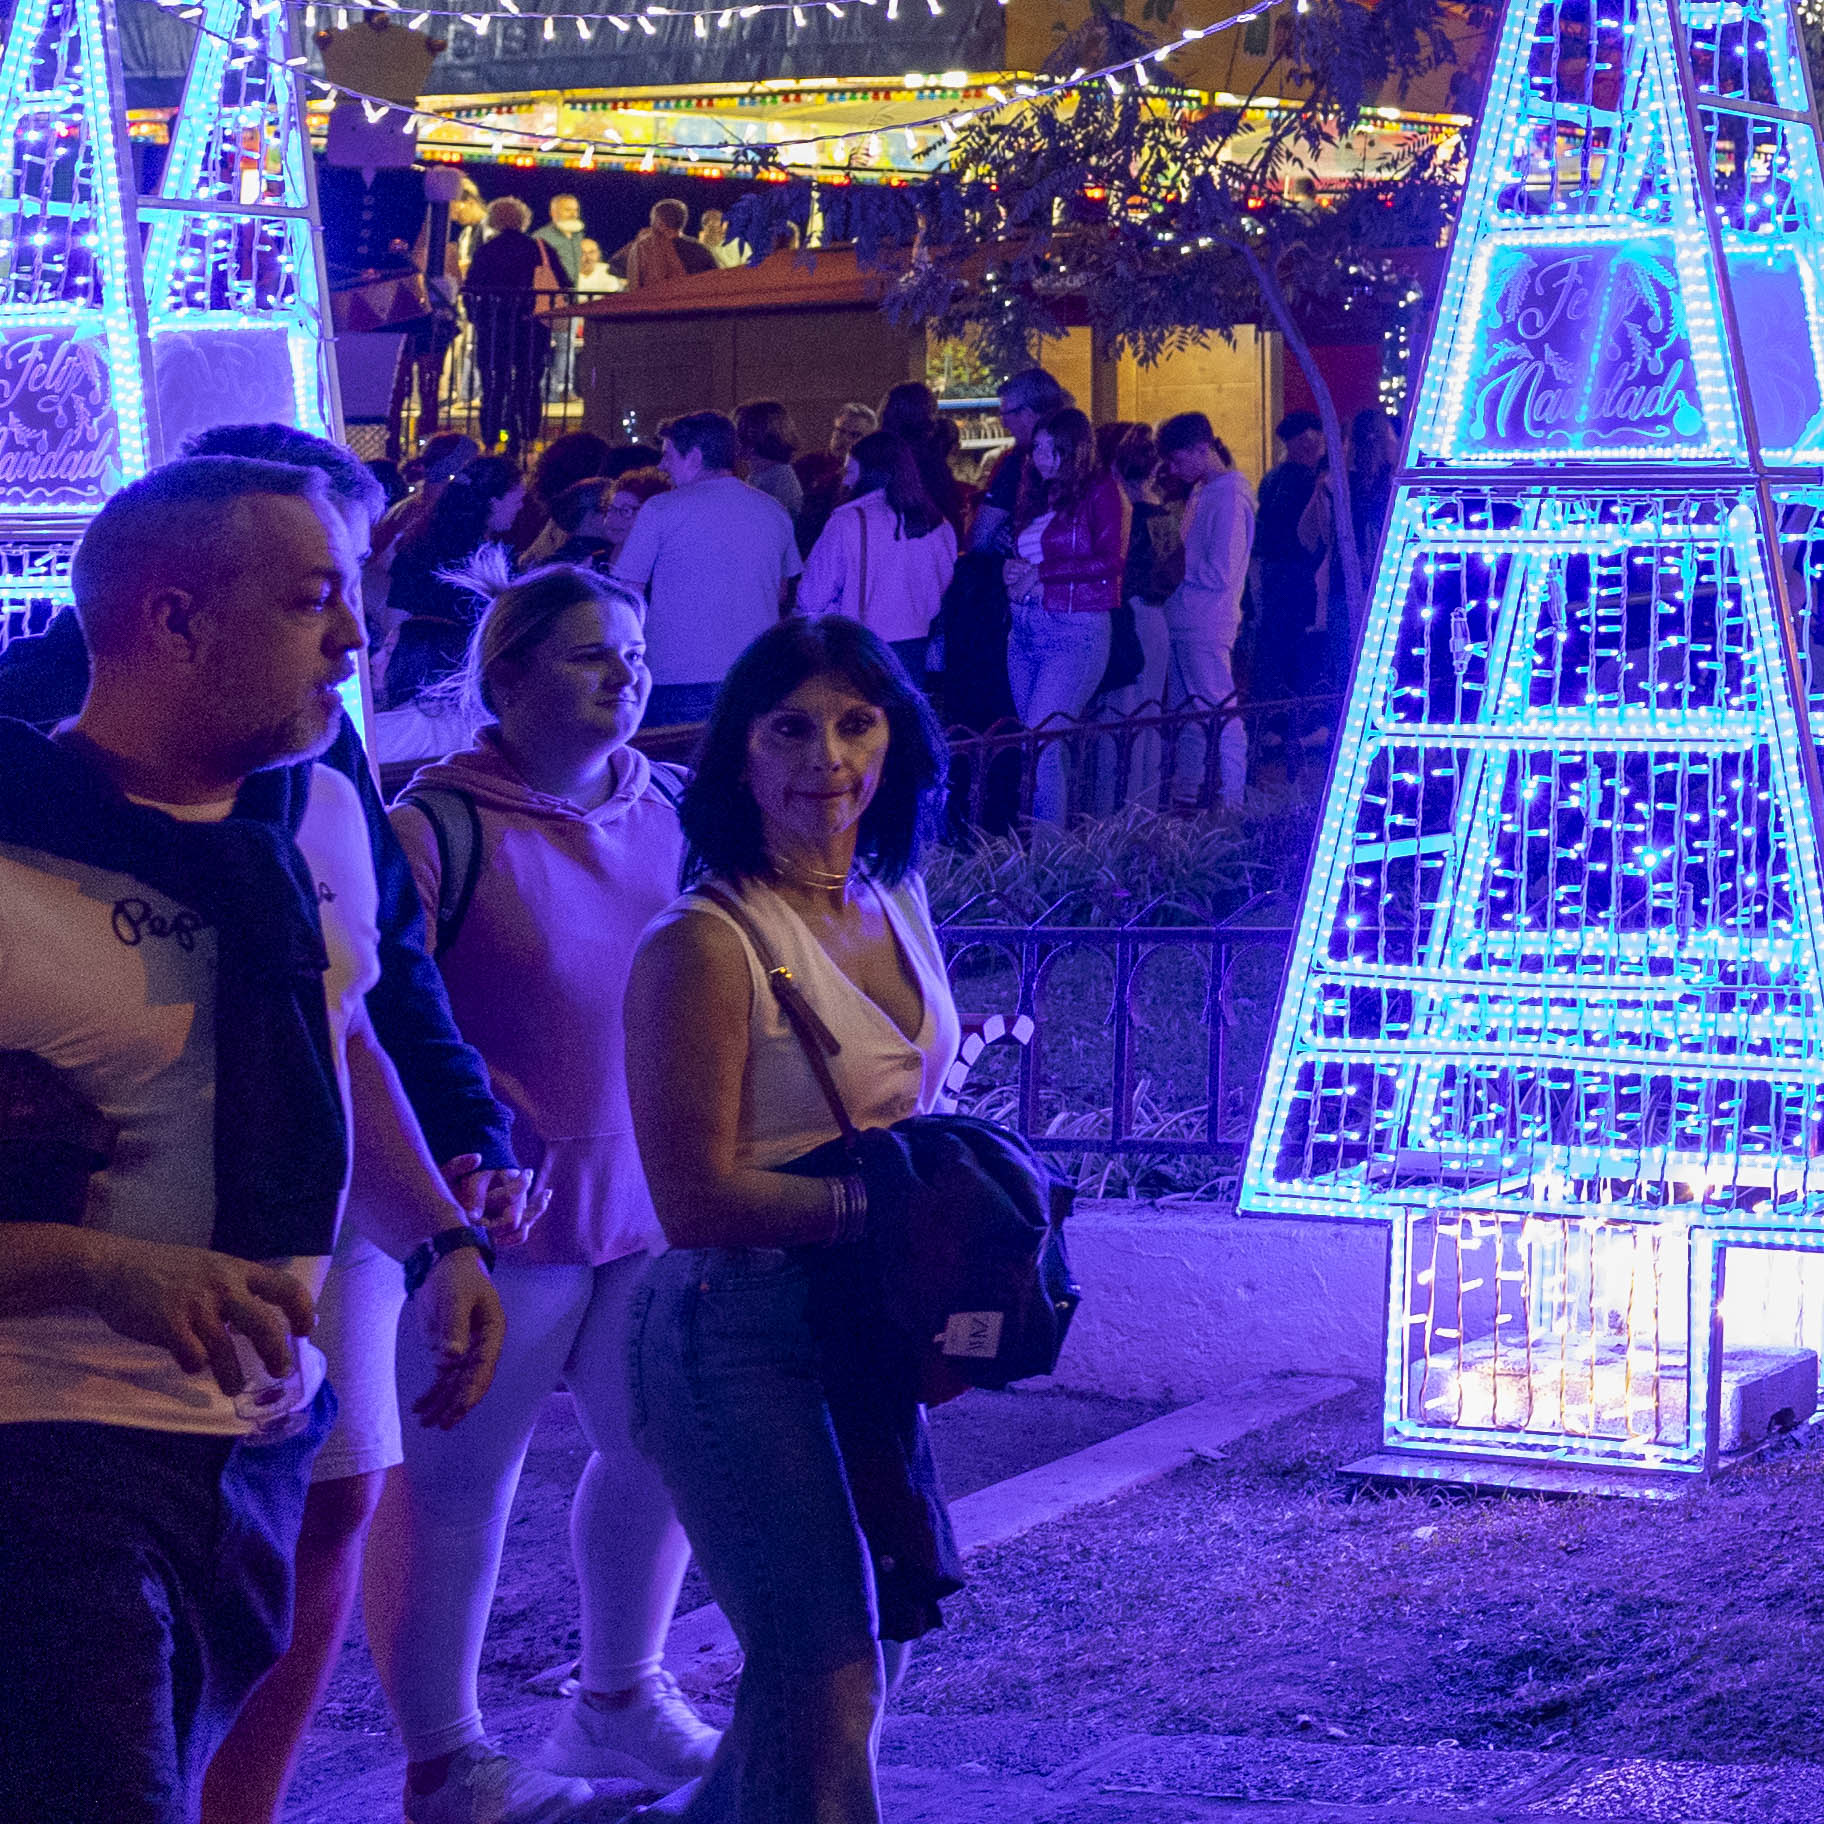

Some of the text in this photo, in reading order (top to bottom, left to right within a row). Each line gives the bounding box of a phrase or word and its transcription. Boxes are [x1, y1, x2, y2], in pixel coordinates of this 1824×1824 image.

[1518, 255, 1641, 342] Fez
[1478, 359, 1684, 439] Nadad
[0, 427, 114, 482] avidad
